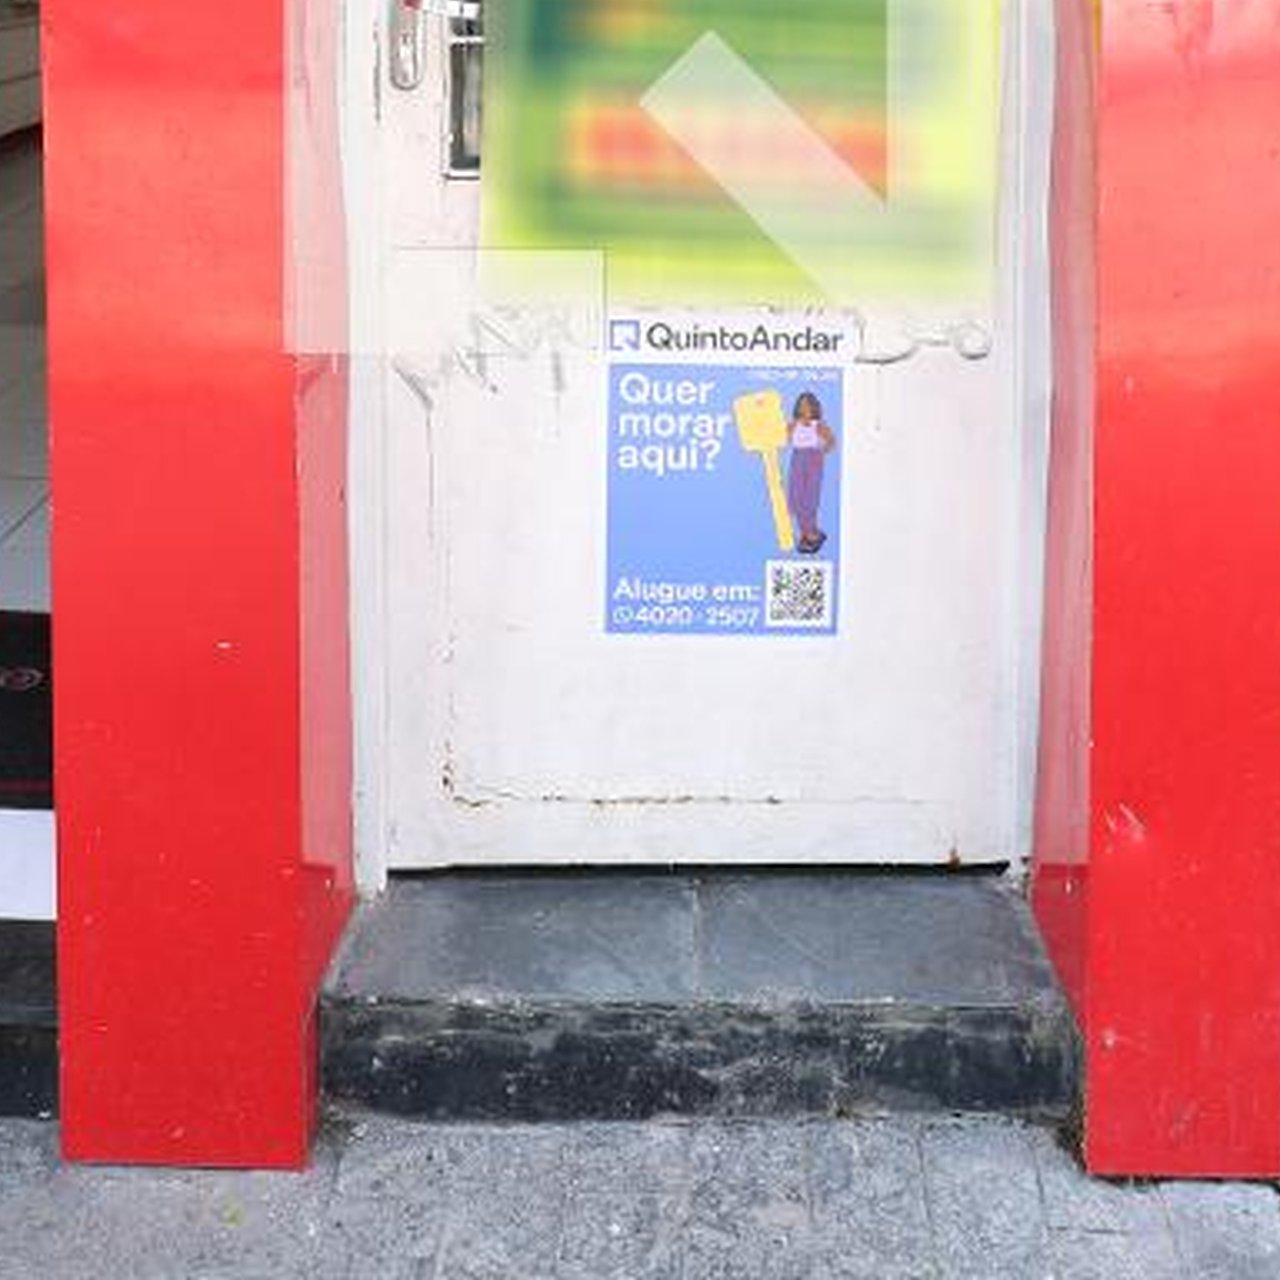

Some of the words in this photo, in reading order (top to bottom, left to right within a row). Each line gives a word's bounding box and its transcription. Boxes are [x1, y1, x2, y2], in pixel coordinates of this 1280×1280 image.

[646, 322, 844, 353] QuintoAndar
[620, 372, 715, 405] Quer
[619, 413, 730, 437] morar
[618, 439, 721, 476] aqui?
[613, 577, 707, 603] Alugue
[712, 585, 761, 602] em:
